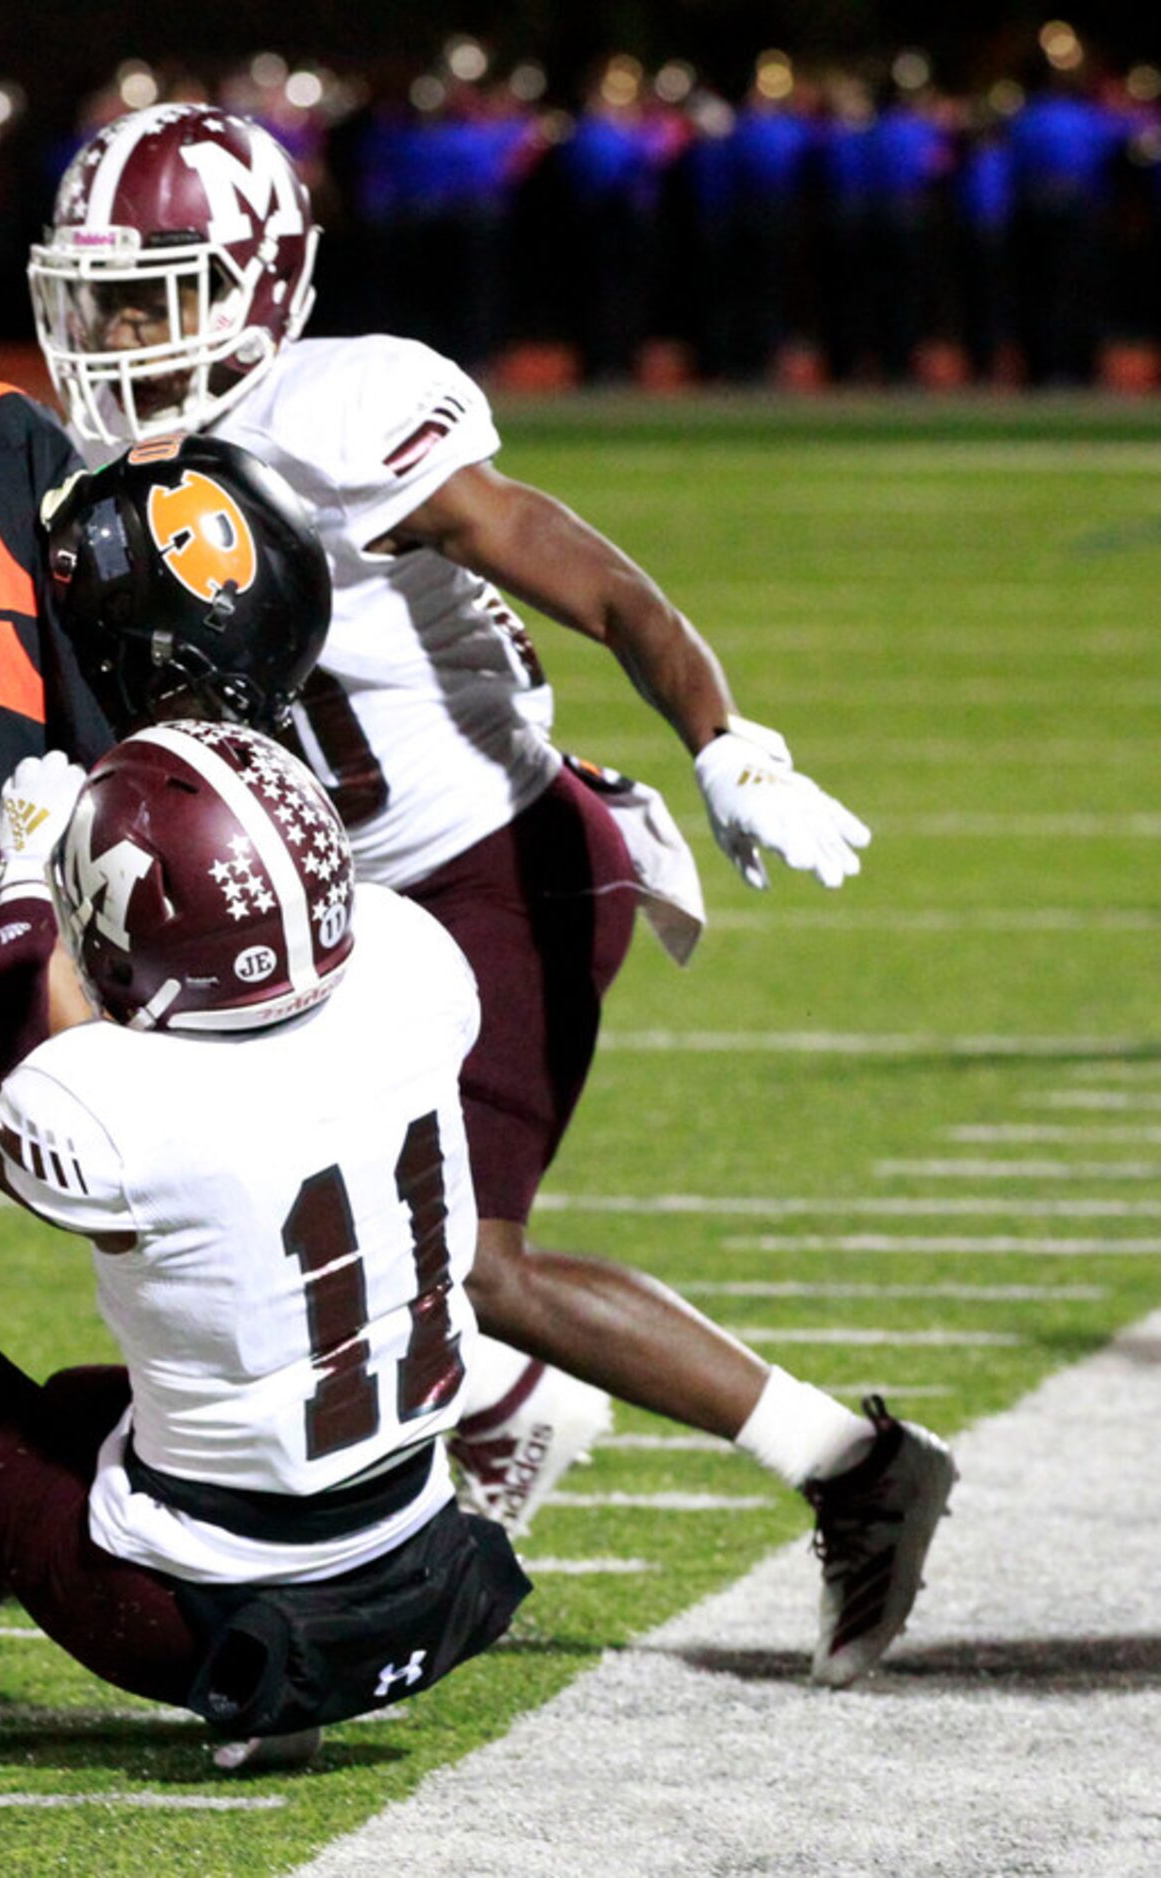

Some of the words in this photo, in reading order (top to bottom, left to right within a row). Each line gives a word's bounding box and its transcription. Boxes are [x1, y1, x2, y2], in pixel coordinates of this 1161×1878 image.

[180, 122, 303, 245] M
[240, 953, 272, 977] JE
[281, 1109, 467, 1461] 11
